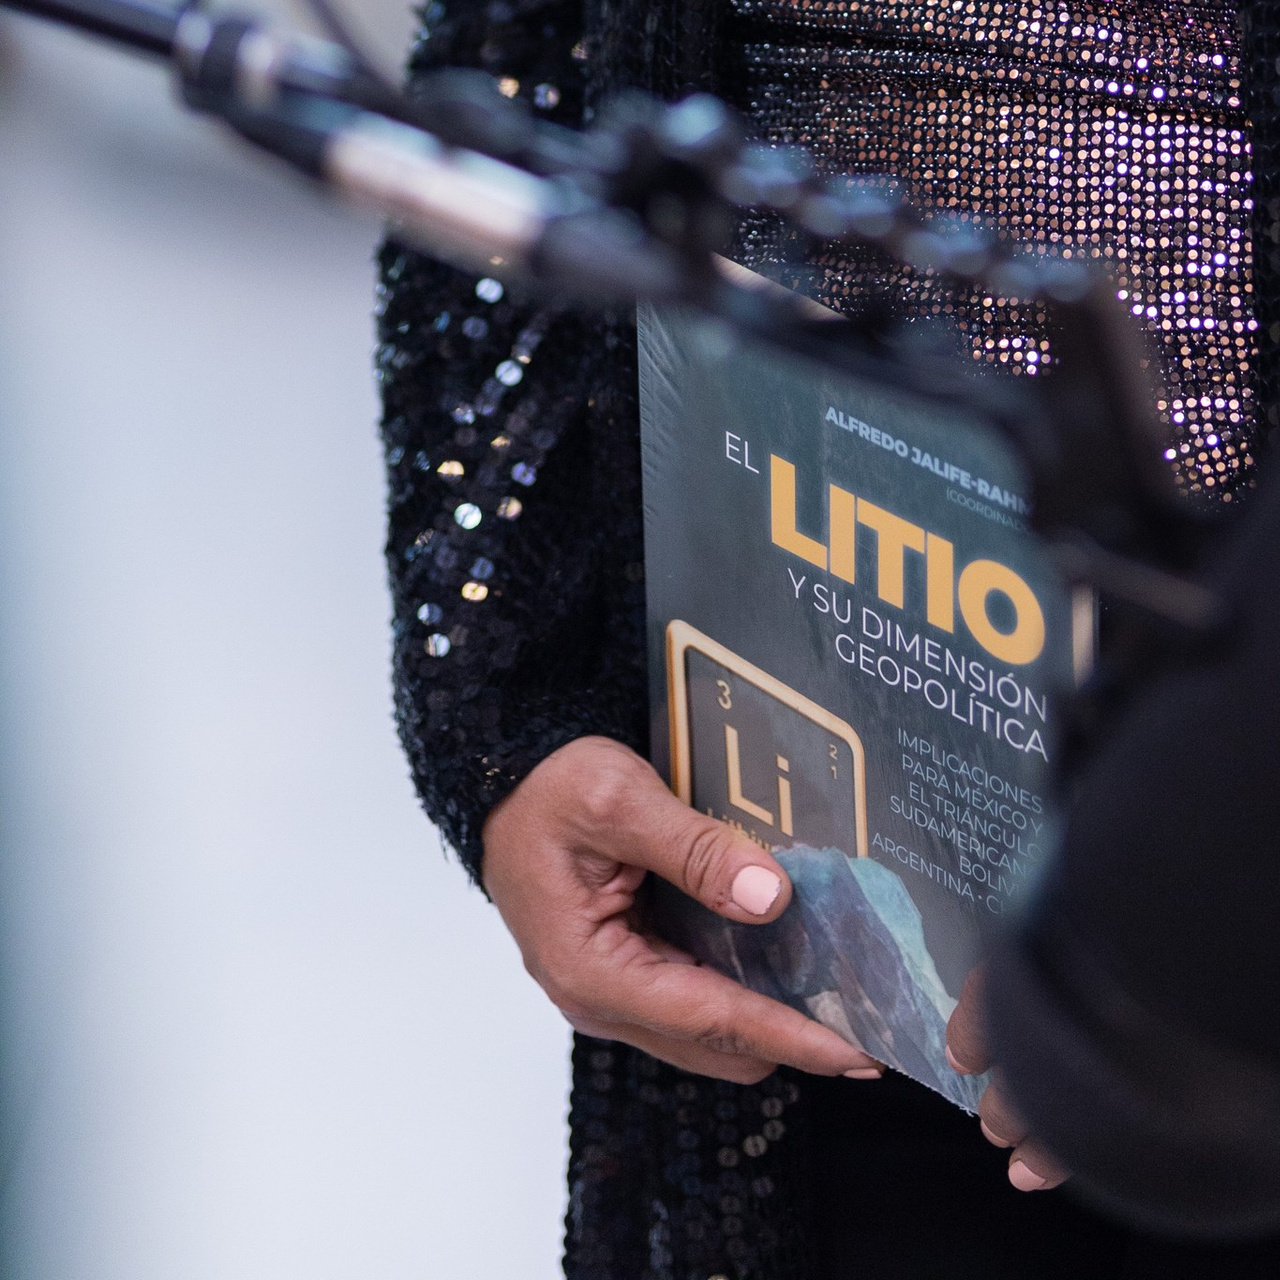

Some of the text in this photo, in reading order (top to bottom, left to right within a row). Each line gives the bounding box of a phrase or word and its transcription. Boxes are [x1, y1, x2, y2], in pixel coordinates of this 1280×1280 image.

[725, 431, 759, 474] EL
[825, 406, 1030, 516] ALFREDO JALIFE-RAHM
[770, 453, 1045, 666] LITIO
[787, 567, 1047, 723] Y SU DIMENSIÓN
[716, 679, 732, 711] 3
[835, 634, 1049, 763] GEOPOLÍTICA
[725, 724, 794, 837] Li
[828, 744, 838, 761] 2
[830, 764, 838, 780] 1
[898, 727, 1043, 814] IMPLICACIONES
[902, 753, 1043, 837] PARA MÉXICO Y
[909, 781, 930, 808] EL
[872, 832, 975, 903] ARGENTINA
[890, 795, 1026, 877] SUDAMERICAN
[959, 855, 1018, 897] BOLIV
